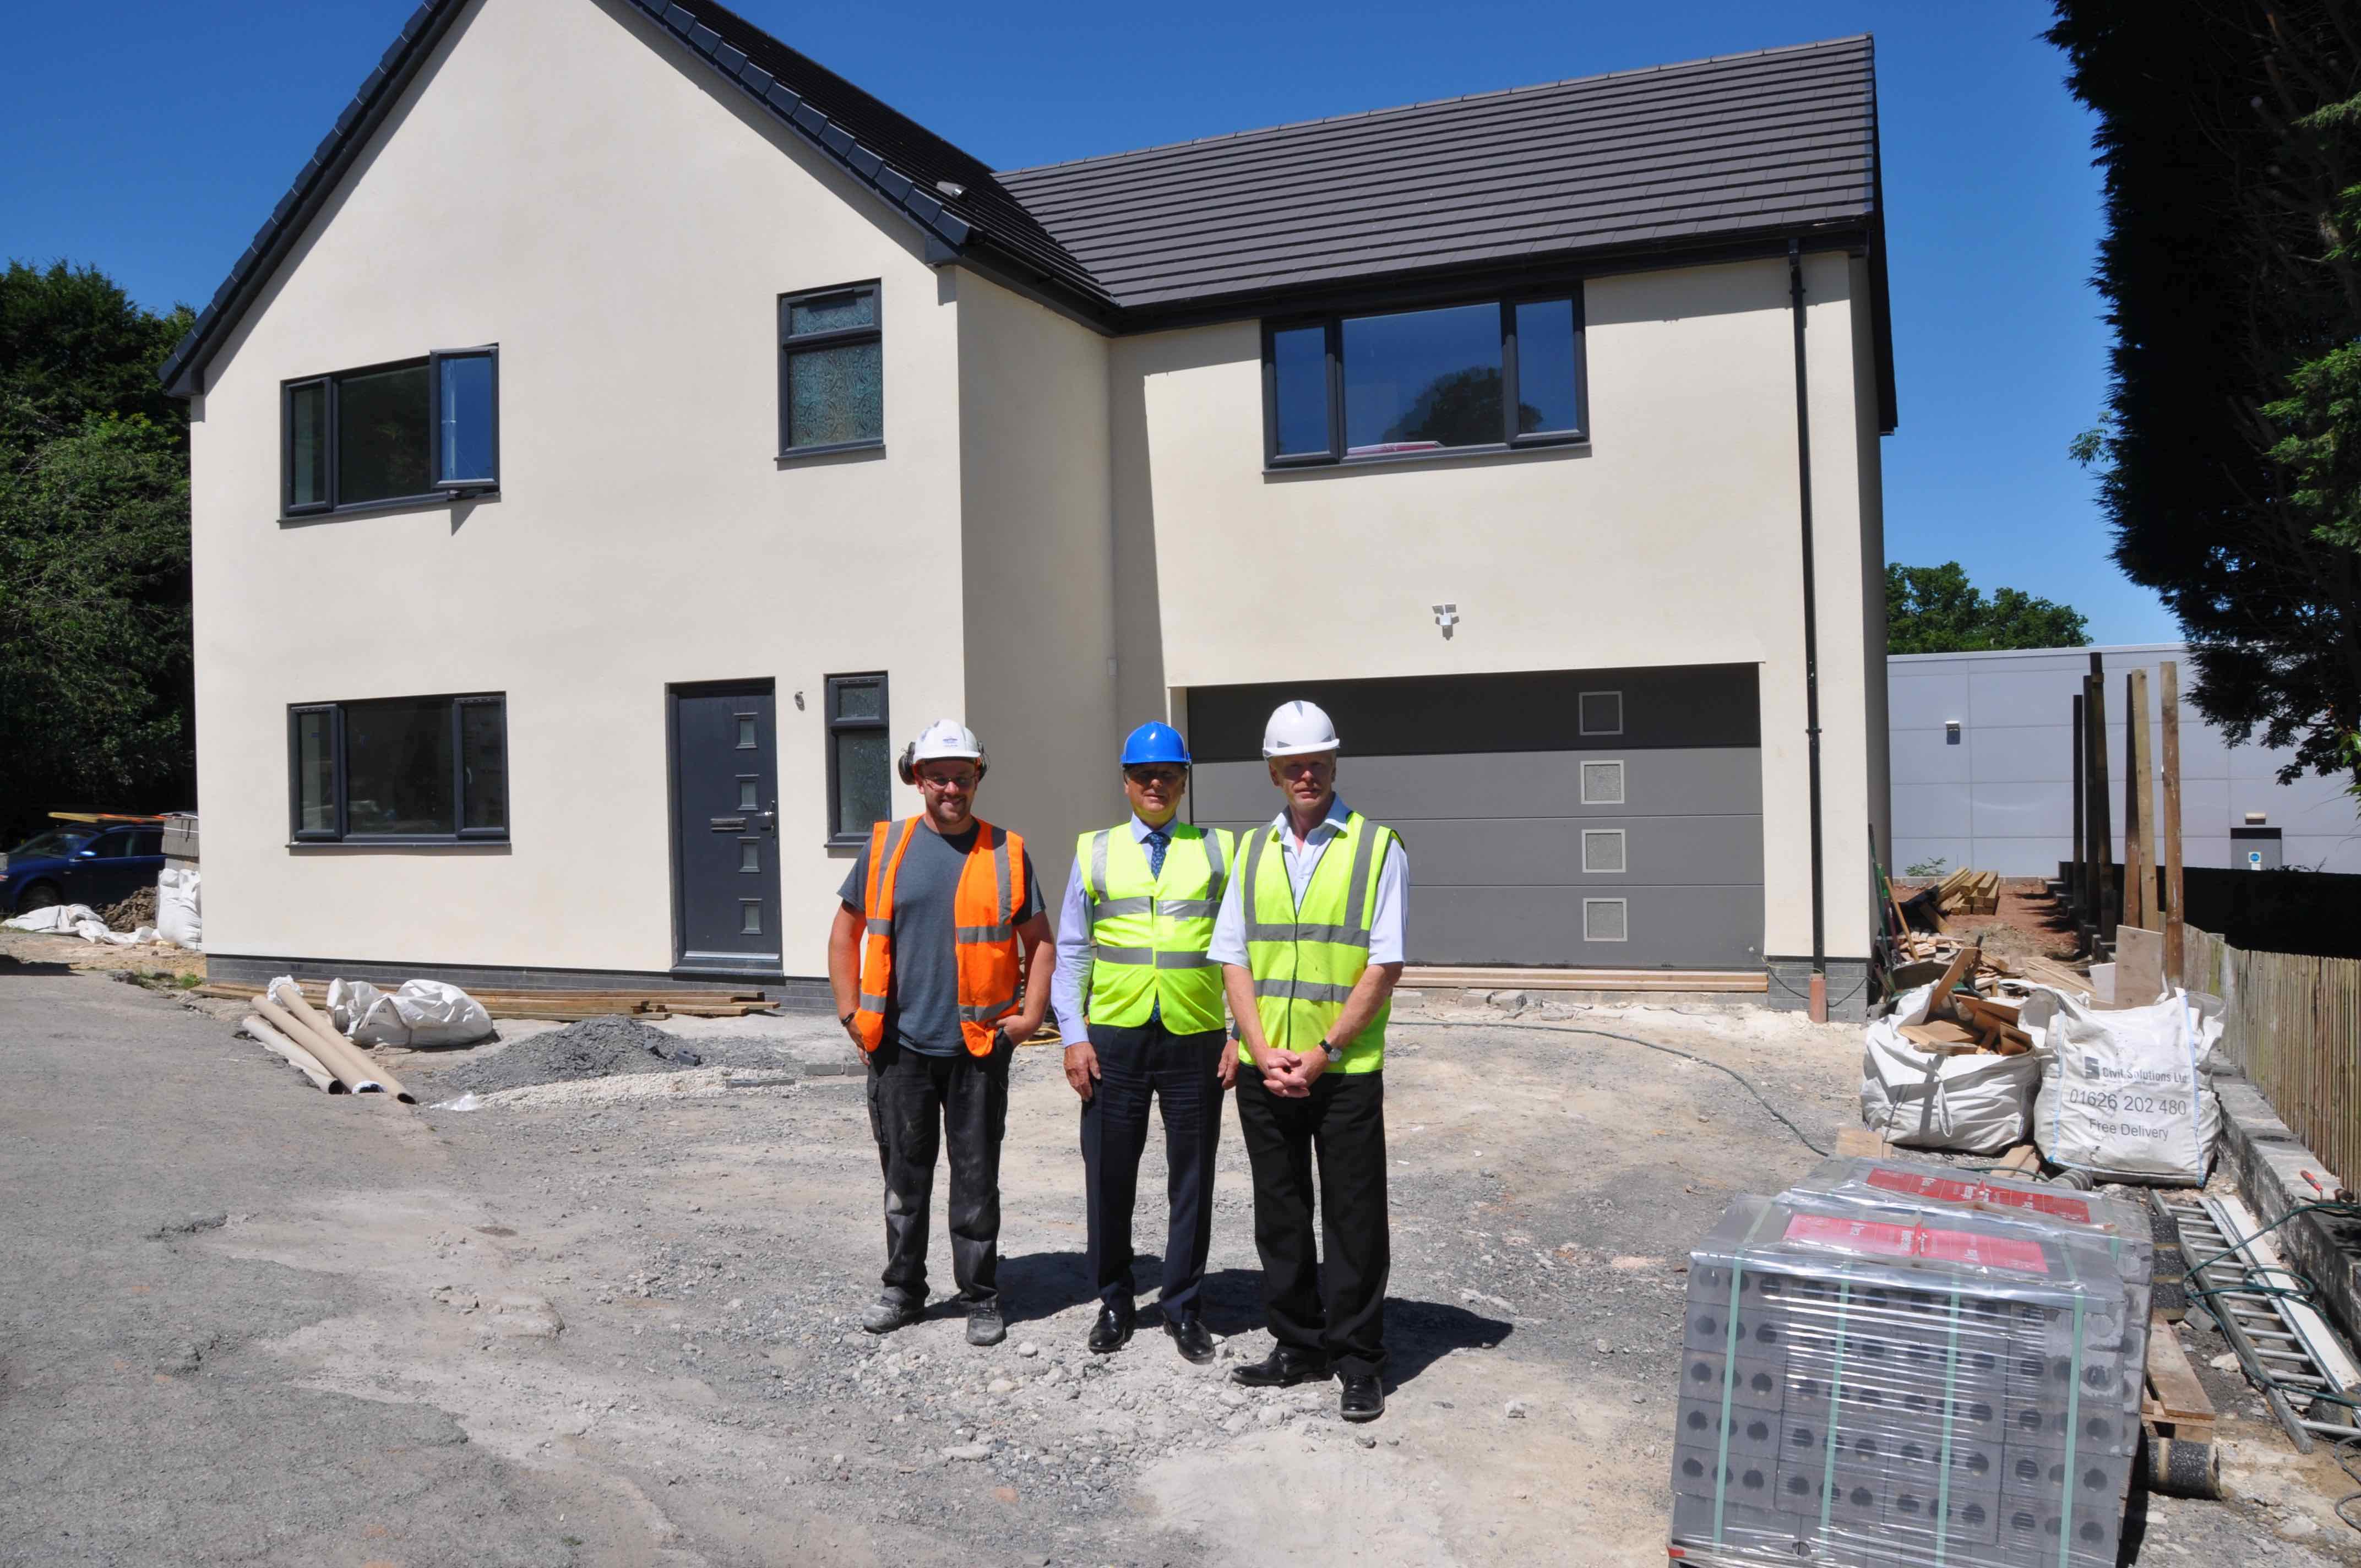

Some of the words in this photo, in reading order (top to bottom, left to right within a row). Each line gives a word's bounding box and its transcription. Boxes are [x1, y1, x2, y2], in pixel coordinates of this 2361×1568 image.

[2102, 1067, 2124, 1078] Civil
[2127, 1069, 2171, 1082] Solutions
[2070, 1088, 2118, 1110] 01626
[2124, 1096, 2154, 1113] 202
[2158, 1099, 2186, 1115] 480
[2090, 1118, 2117, 1134] Free
[2120, 1124, 2168, 1141] Delivery
